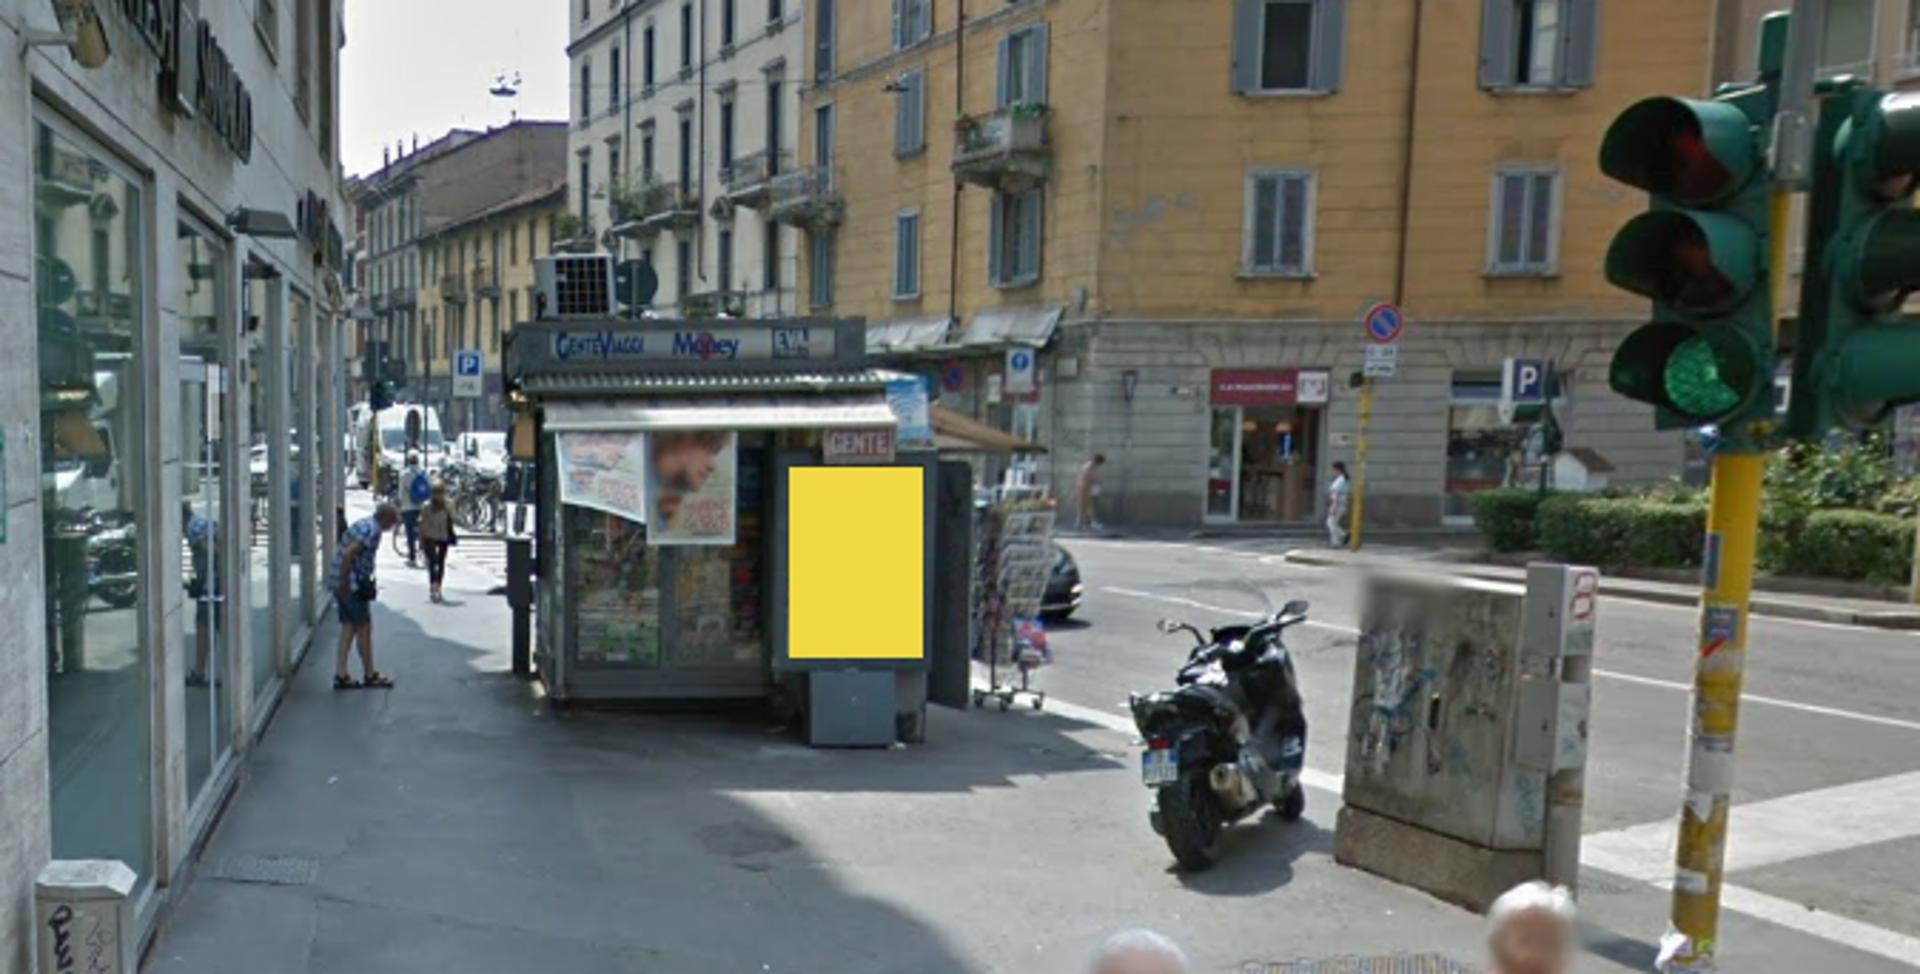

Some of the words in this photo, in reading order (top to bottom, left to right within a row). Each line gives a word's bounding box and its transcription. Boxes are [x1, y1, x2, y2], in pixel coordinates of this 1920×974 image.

[462, 356, 476, 375] P
[1519, 366, 1537, 395] P
[831, 431, 888, 455] GENTE
